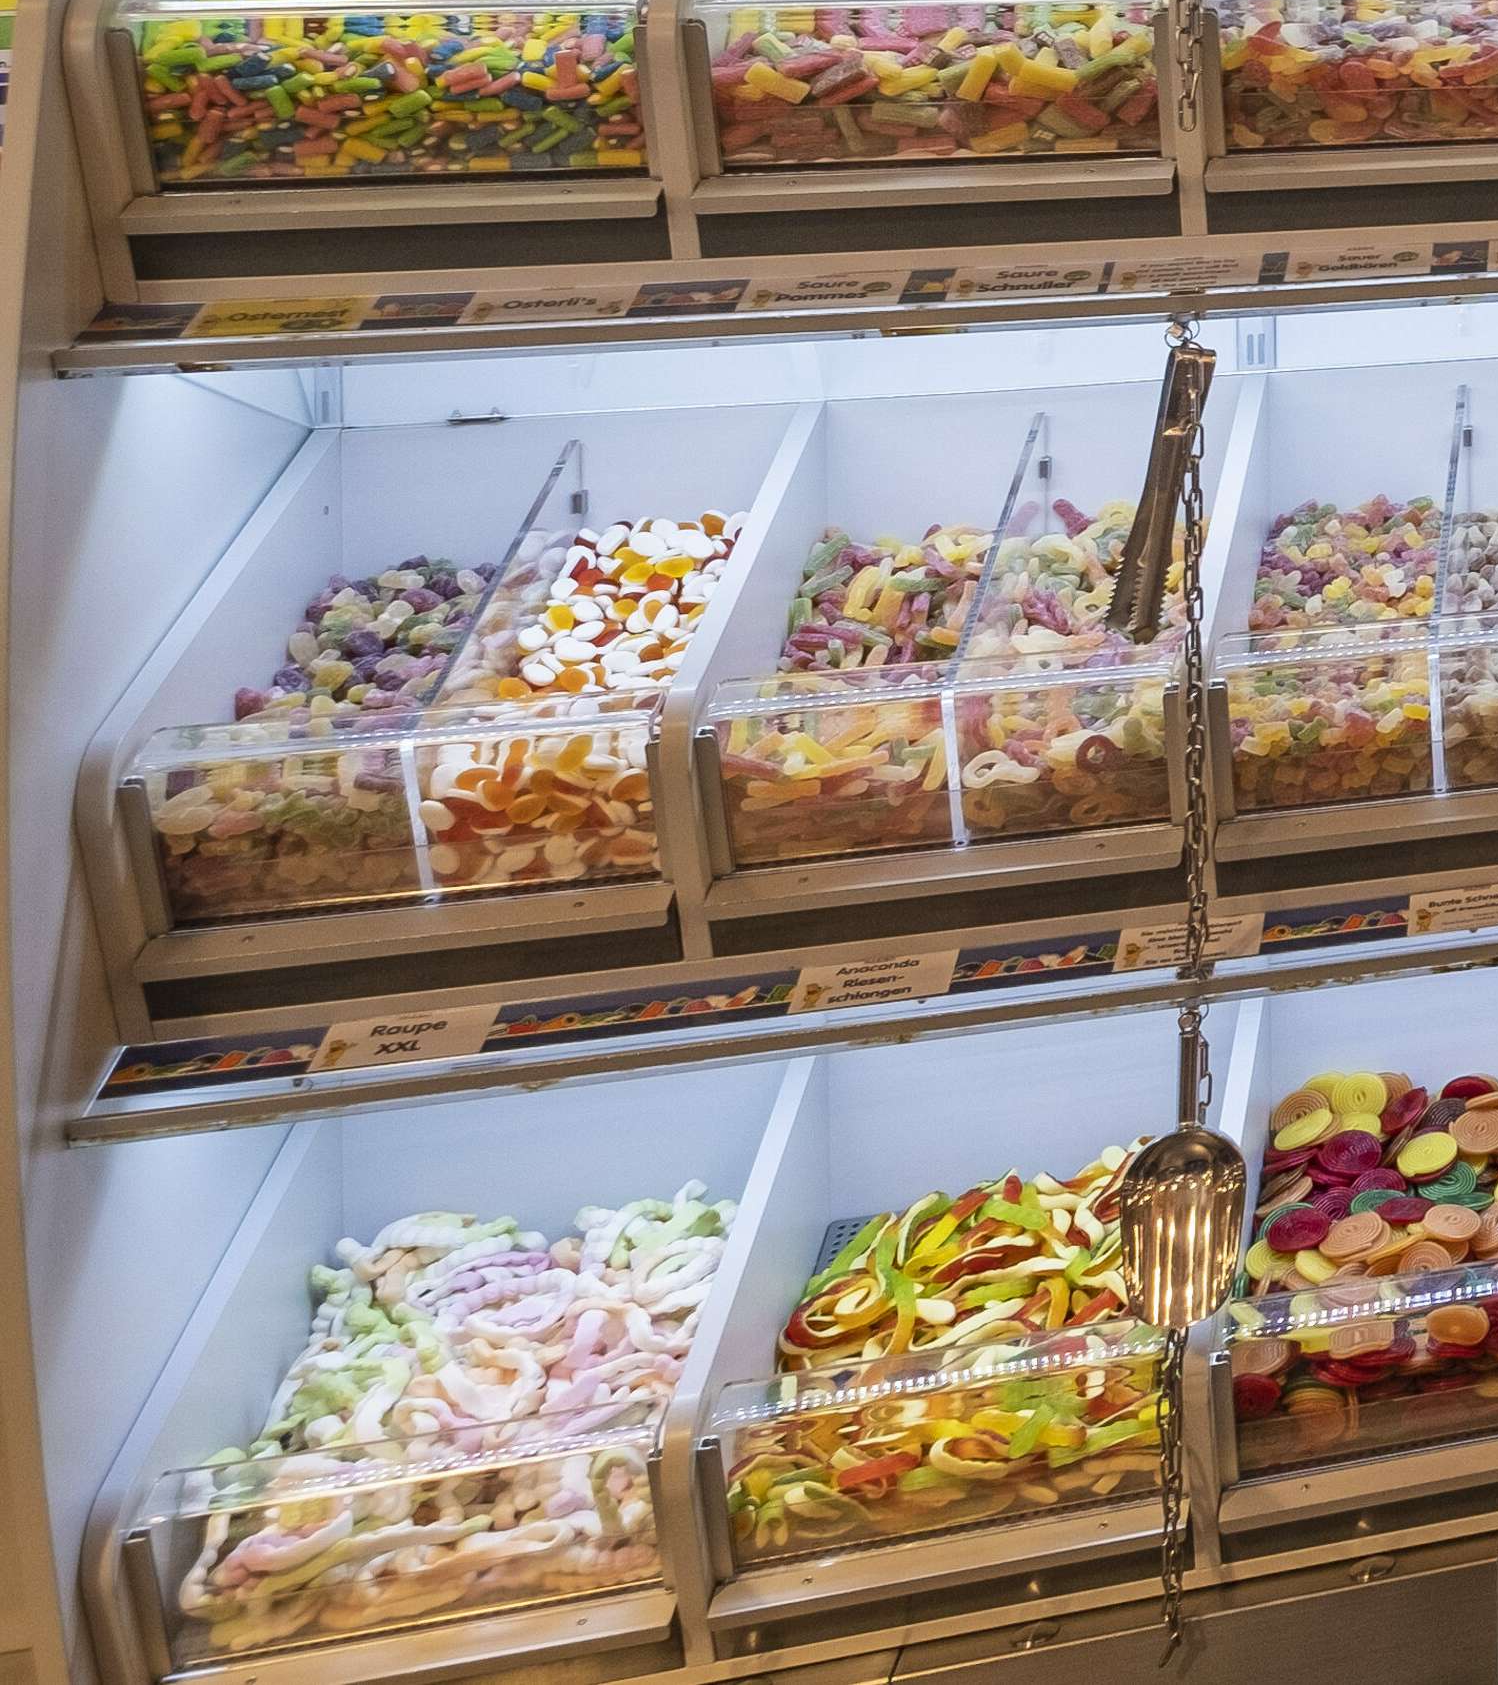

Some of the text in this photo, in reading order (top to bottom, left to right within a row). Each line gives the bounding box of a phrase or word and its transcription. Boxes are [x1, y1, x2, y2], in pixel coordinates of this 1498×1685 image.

[1339, 254, 1382, 263] Sauer
[1319, 261, 1397, 273] Goldbären
[998, 269, 1060, 280] Saure
[799, 280, 858, 291] Saure
[975, 279, 1076, 293] Schnuller
[775, 290, 868, 303] Pommes
[1429, 897, 1463, 908] Bunte
[836, 958, 920, 977] Anaconda
[842, 974, 905, 988] Riesen-
[827, 985, 912, 1004] schlangen
[370, 1020, 448, 1038] Raupe
[374, 1039, 421, 1055] XXL
